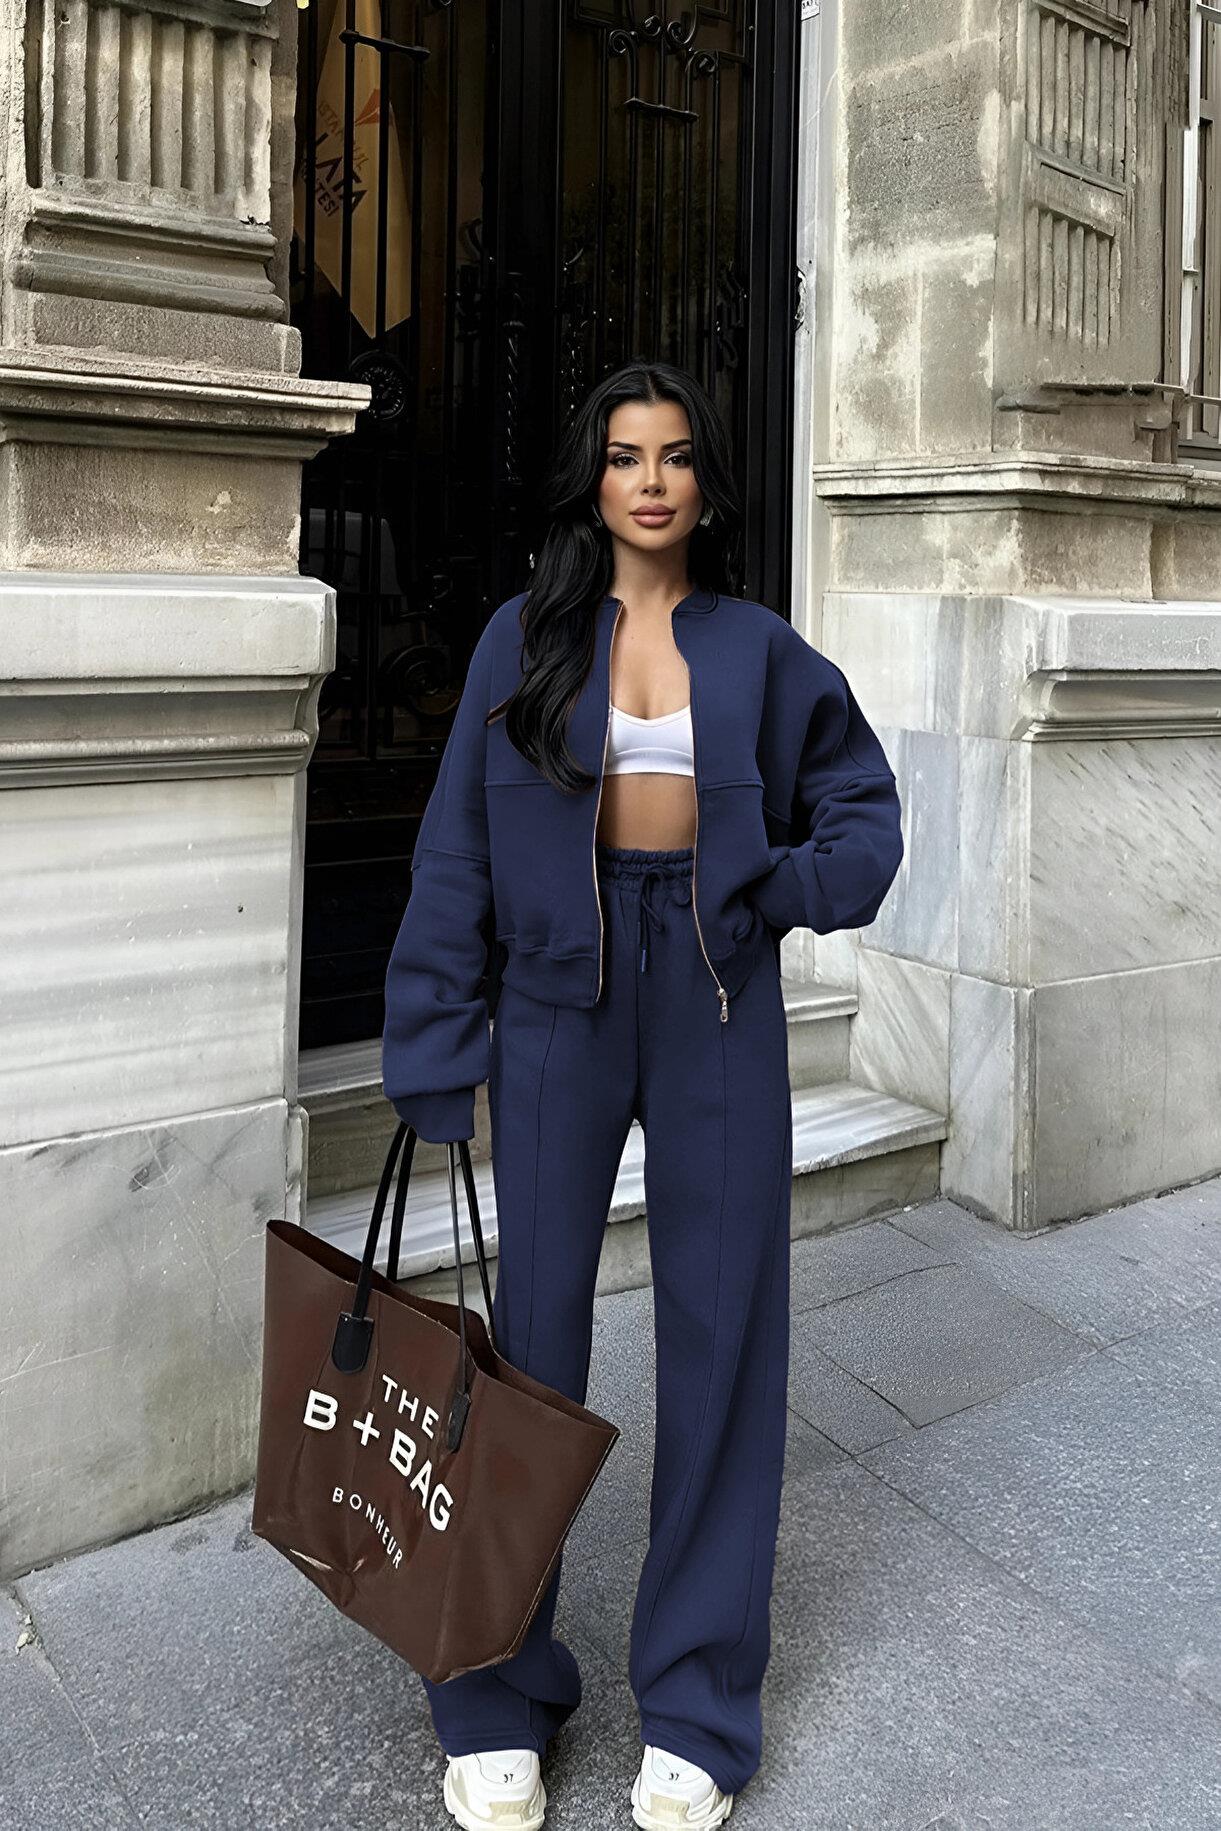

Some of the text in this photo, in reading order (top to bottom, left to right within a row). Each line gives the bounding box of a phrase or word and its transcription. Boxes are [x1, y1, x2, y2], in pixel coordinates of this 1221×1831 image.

[303, 1389, 339, 1431] B
[382, 1374, 439, 1439] THE
[332, 1487, 403, 1569] BONHEUR
